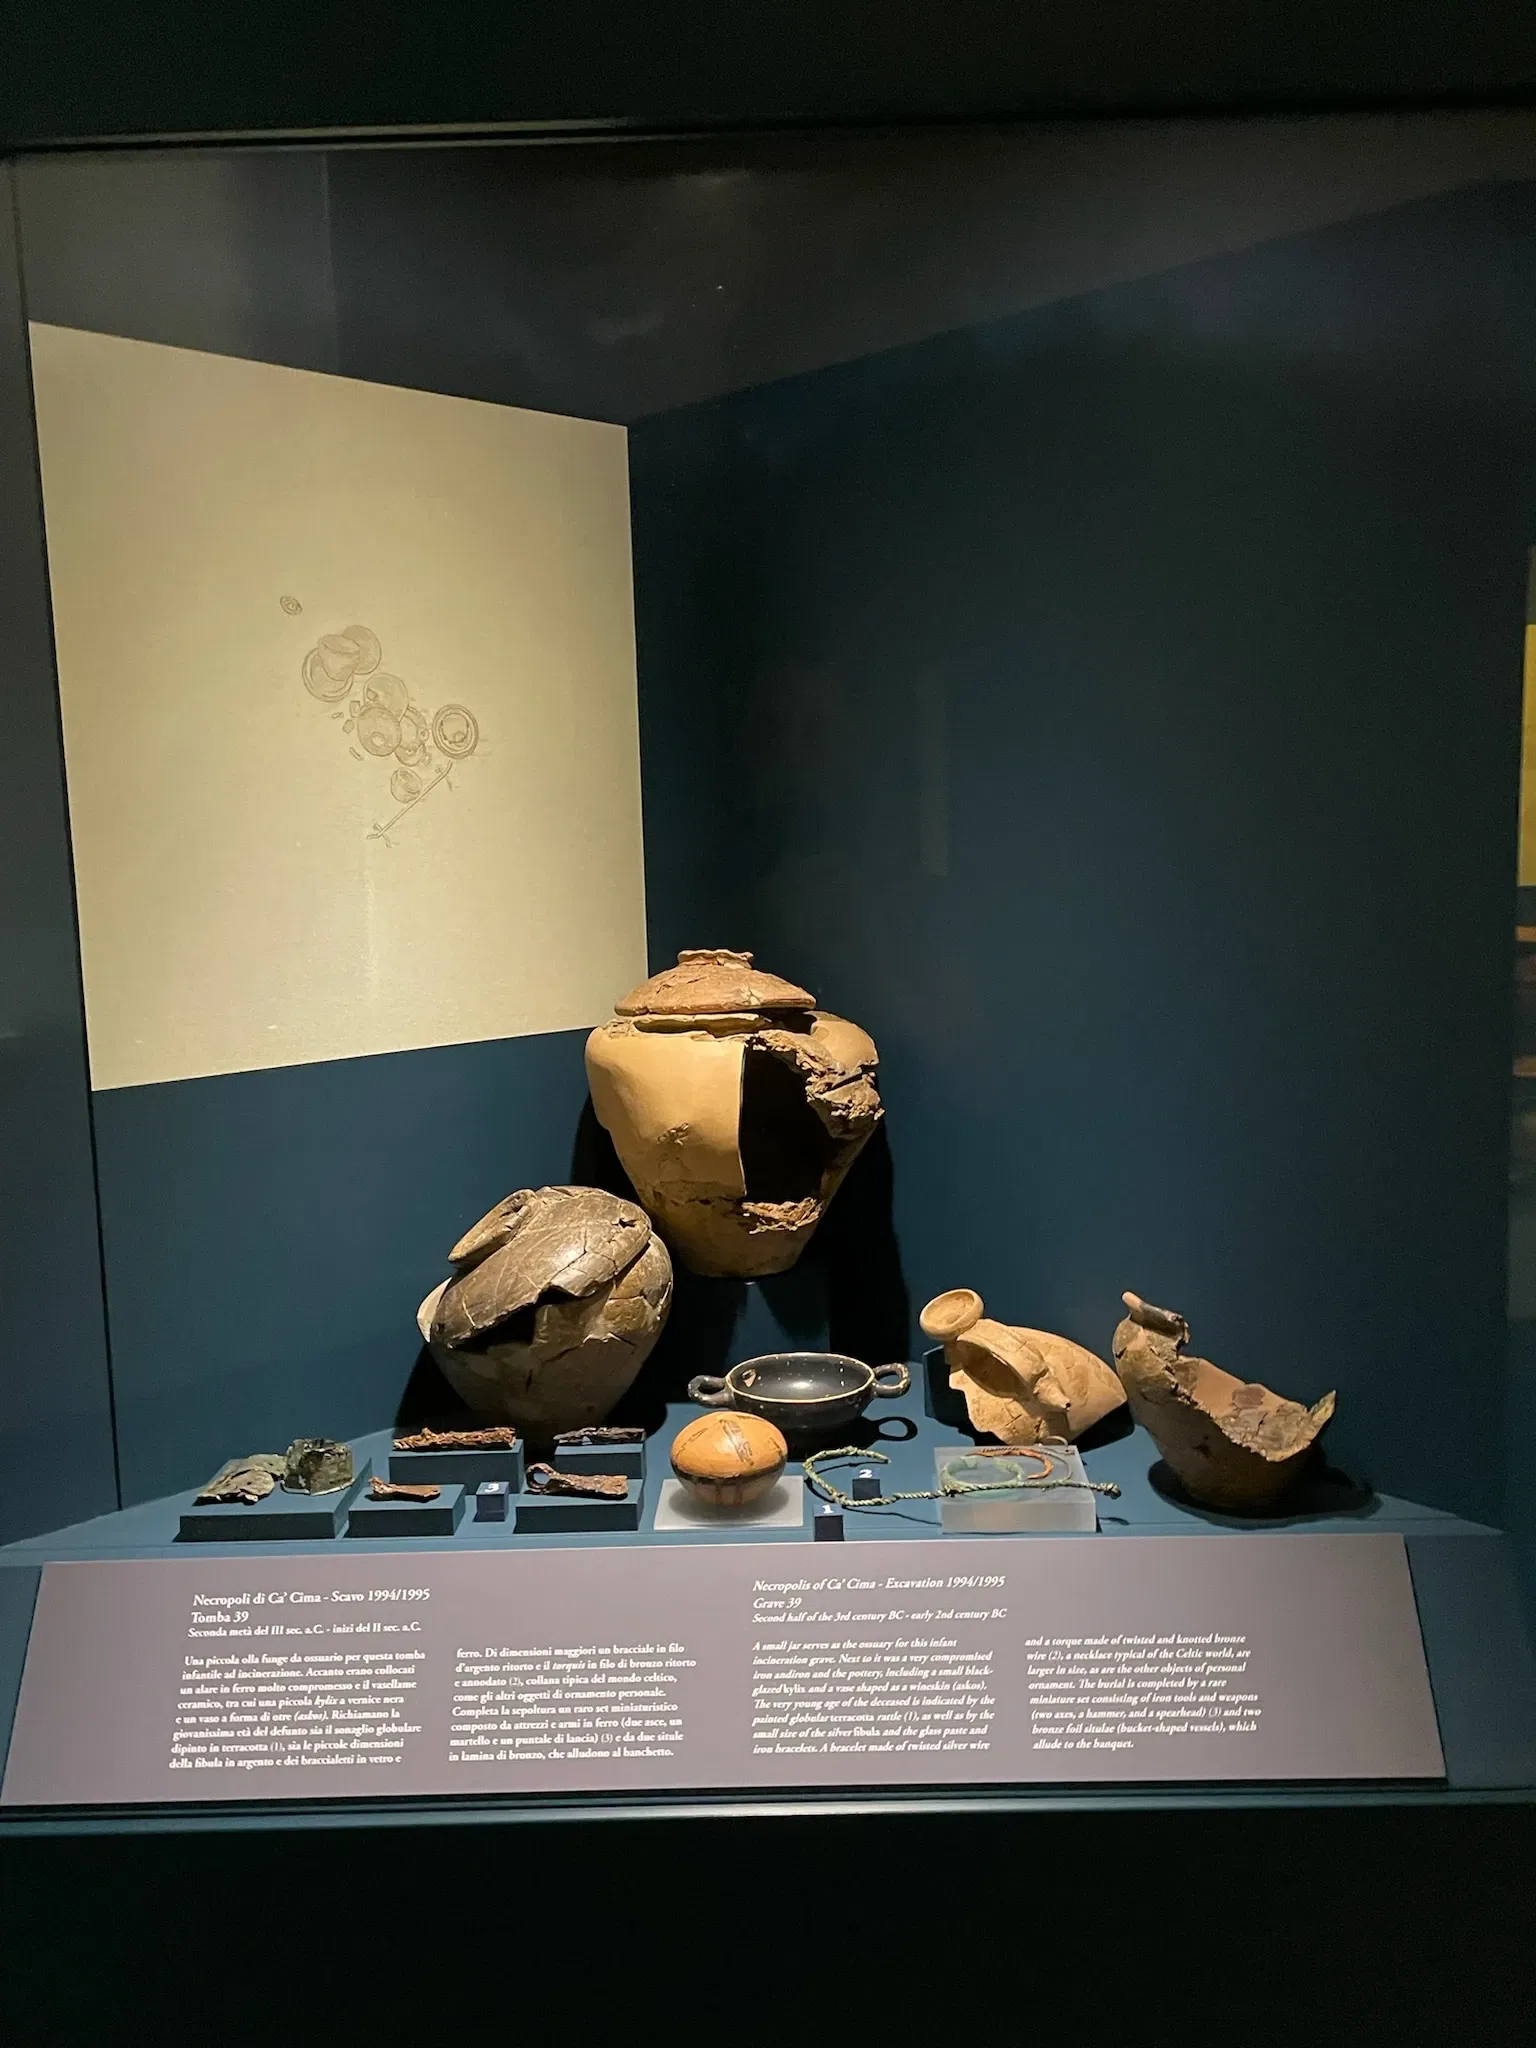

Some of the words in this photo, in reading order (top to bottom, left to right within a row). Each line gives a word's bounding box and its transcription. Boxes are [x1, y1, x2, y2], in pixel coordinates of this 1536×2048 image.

[858, 1468, 873, 1479] 2
[484, 1482, 500, 1493] 3
[822, 1504, 835, 1514] 1
[752, 1579, 810, 1593] Necropolis
[812, 1579, 827, 1590] of
[846, 1578, 875, 1589] Cima
[885, 1577, 944, 1589] Excavation
[946, 1575, 1006, 1587] 1994/1995
[193, 1593, 250, 1608] Necropoli
[252, 1593, 265, 1604] di
[289, 1592, 321, 1603] Cima
[330, 1591, 364, 1601] Scavo
[368, 1589, 429, 1601] 1994/1995
[753, 1597, 784, 1608] Grave
[785, 1597, 802, 1608] 39
[191, 1611, 230, 1623] Tomba
[232, 1611, 248, 1622] 39
[752, 1612, 786, 1622] Second
[786, 1612, 806, 1621] half
[806, 1612, 818, 1621] of
[817, 1612, 833, 1621] the
[833, 1611, 851, 1621] 3rd
[851, 1613, 887, 1622] century
[887, 1610, 904, 1619] BC
[910, 1610, 933, 1622] early
[934, 1609, 954, 1618] 2nd
[954, 1611, 989, 1620] century
[990, 1608, 1007, 1618] BC
[187, 1627, 227, 1637] Seconda
[228, 1626, 252, 1636] metà
[253, 1626, 269, 1635] del
[270, 1625, 284, 1635] III
[332, 1624, 353, 1633] inizi
[355, 1623, 370, 1632] del
[372, 1623, 381, 1632] II
[761, 1641, 787, 1650] small
[786, 1640, 801, 1652] jar
[841, 1640, 857, 1648] the
[858, 1641, 893, 1650] ossuary
[894, 1639, 909, 1647] for
[910, 1638, 927, 1647] this
[929, 1638, 957, 1647] infant
[1024, 1636, 1043, 1645] and
[1051, 1638, 1082, 1648] torque
[1083, 1635, 1109, 1645] made
[1110, 1635, 1122, 1644] of
[1122, 1635, 1155, 1644] twisted
[1156, 1635, 1175, 1644] and
[1176, 1634, 1212, 1643] knotted
[1213, 1634, 1245, 1643] bronze
[456, 1648, 482, 1658] ferro.
[484, 1647, 497, 1657] Di
[499, 1647, 551, 1656] dimensioni
[553, 1645, 596, 1658] maggiori
[612, 1644, 654, 1654] bracciale
[656, 1644, 666, 1653] in
[668, 1644, 684, 1652] filo
[184, 1656, 204, 1665] Una
[205, 1655, 239, 1668] piccola
[241, 1655, 259, 1664] olla
[261, 1654, 288, 1666] funge
[289, 1653, 302, 1662] da
[303, 1652, 343, 1662] ossuario
[344, 1654, 361, 1664] per
[362, 1653, 393, 1663] questa
[394, 1650, 425, 1659] tomba
[752, 1655, 808, 1664] incineration
[808, 1657, 836, 1666] grave.
[838, 1654, 860, 1663] Next
[873, 1653, 881, 1662] it
[909, 1655, 929, 1664] very
[930, 1652, 992, 1663] compromised
[182, 1669, 222, 1680] infantile
[223, 1669, 236, 1678] ad
[237, 1668, 303, 1678] incinerazione.
[305, 1667, 344, 1676] Accanto
[374, 1665, 415, 1674] collocati
[194, 1684, 218, 1694] alare
[219, 1684, 230, 1693] in
[232, 1684, 255, 1693] ferro
[257, 1683, 286, 1692] molto
[287, 1683, 352, 1693] compromesso
[362, 1681, 369, 1689] il
[371, 1680, 416, 1689] vasellame
[1028, 1681, 1075, 1689] ornament.
[1078, 1679, 1096, 1688] The
[1097, 1679, 1125, 1688] burial
[1126, 1678, 1135, 1688] is
[1136, 1678, 1185, 1690] completed
[1186, 1678, 1199, 1689] by
[1207, 1679, 1226, 1687] rare
[479, 1691, 493, 1704] gli
[494, 1690, 515, 1700] altri
[517, 1690, 550, 1703] oggetti
[551, 1690, 562, 1699] di
[564, 1690, 616, 1698] ornamento
[618, 1688, 666, 1700] personale.
[452, 1706, 498, 1718] Completa
[500, 1706, 510, 1715] la
[511, 1705, 556, 1717] sepoltura
[595, 1704, 608, 1712] set
[610, 1703, 677, 1712] miniaturistico
[172, 1728, 234, 1741] giovanissima
[236, 1727, 251, 1736] età
[252, 1727, 268, 1736] del
[269, 1726, 307, 1736] defunto
[308, 1725, 323, 1735] sia
[324, 1725, 332, 1734] il
[334, 1724, 374, 1737] sonaglio
[375, 1723, 421, 1736] globulare
[1031, 1724, 1064, 1734] bronze
[1065, 1723, 1083, 1733] foil
[1083, 1723, 1115, 1733] situlae
[1228, 1722, 1256, 1731] which
[1032, 1739, 1062, 1749] allude
[1063, 1740, 1074, 1748] to
[1075, 1739, 1092, 1748] the
[1092, 1739, 1133, 1751] banquet.
[448, 1751, 459, 1761] in
[461, 1751, 494, 1760] lamina
[495, 1750, 506, 1760] di
[508, 1750, 545, 1759] bronzo,
[547, 1749, 565, 1758] che
[566, 1749, 609, 1758] alludono
[611, 1748, 621, 1757] al
[623, 1748, 673, 1756] banchetto.
